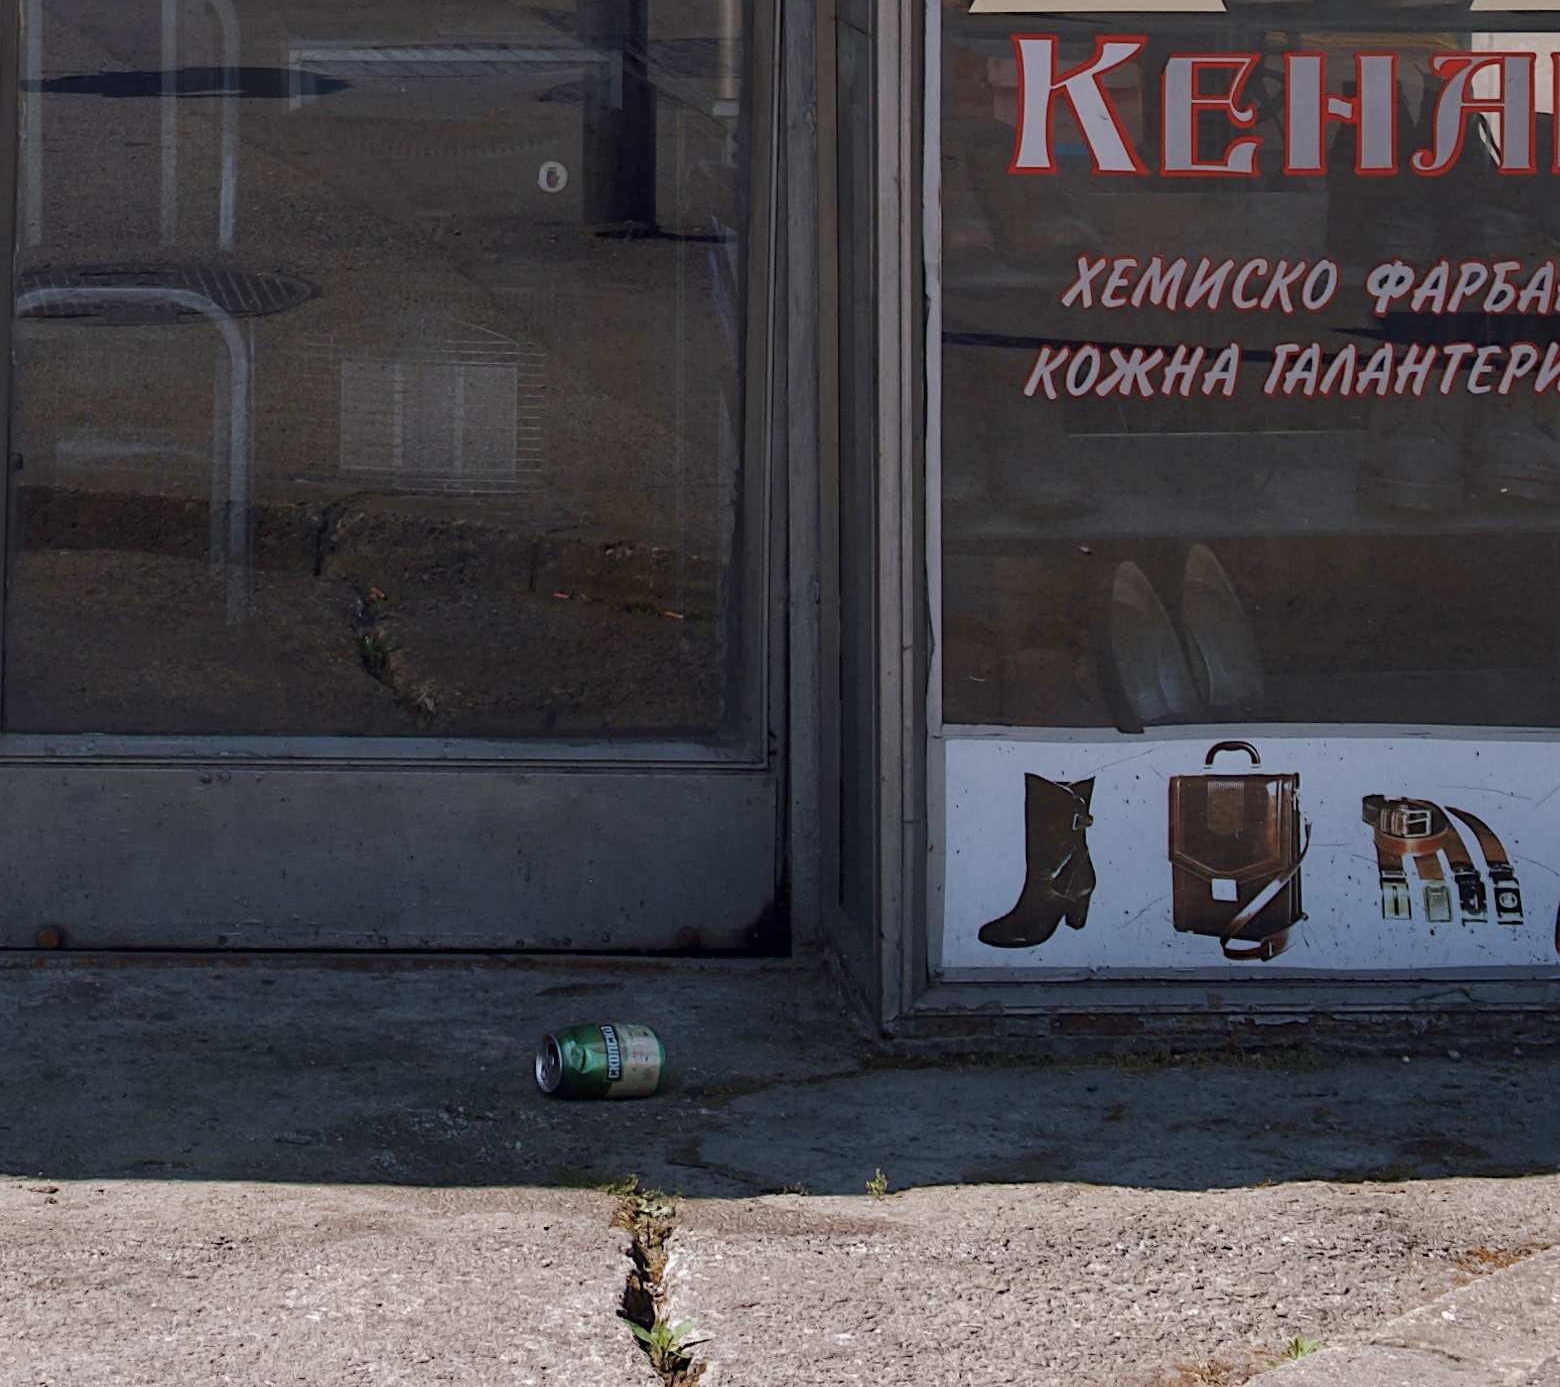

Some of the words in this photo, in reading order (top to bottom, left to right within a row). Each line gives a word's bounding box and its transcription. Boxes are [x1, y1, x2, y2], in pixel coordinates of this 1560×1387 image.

[1060, 253, 1339, 315] ХЕМИСКО
[1023, 341, 1240, 401] КОЖНА
[600, 1025, 621, 1079] СКОПСКО
